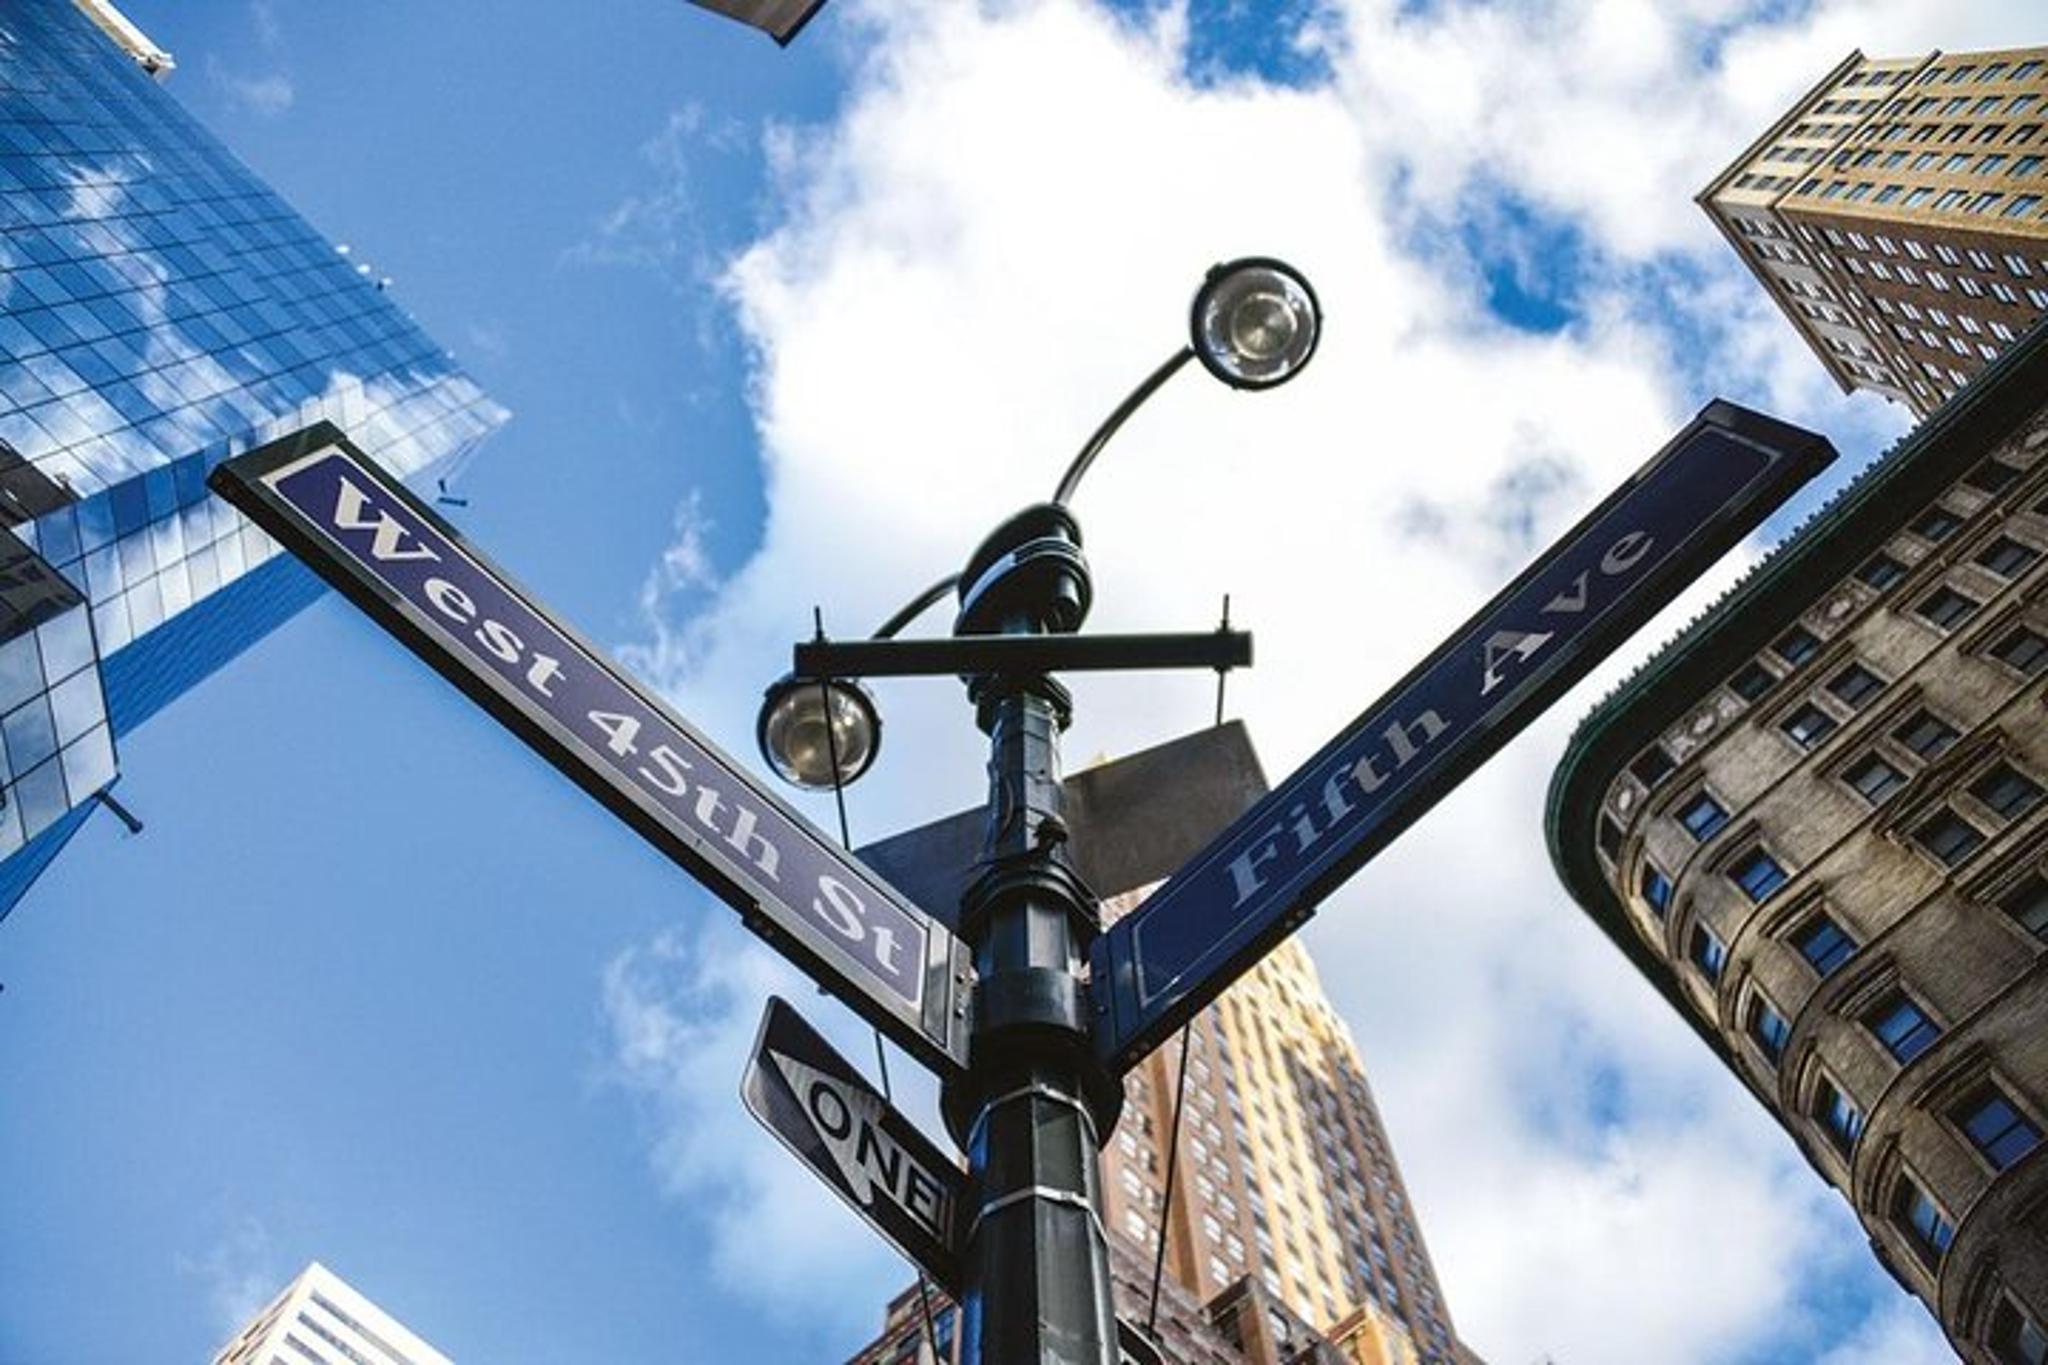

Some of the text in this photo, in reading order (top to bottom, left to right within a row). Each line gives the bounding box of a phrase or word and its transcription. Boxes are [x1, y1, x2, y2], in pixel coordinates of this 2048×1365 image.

[333, 476, 903, 976] West 45th St
[1226, 530, 1653, 909] Fifth Ave
[810, 1080, 943, 1238] ONE
